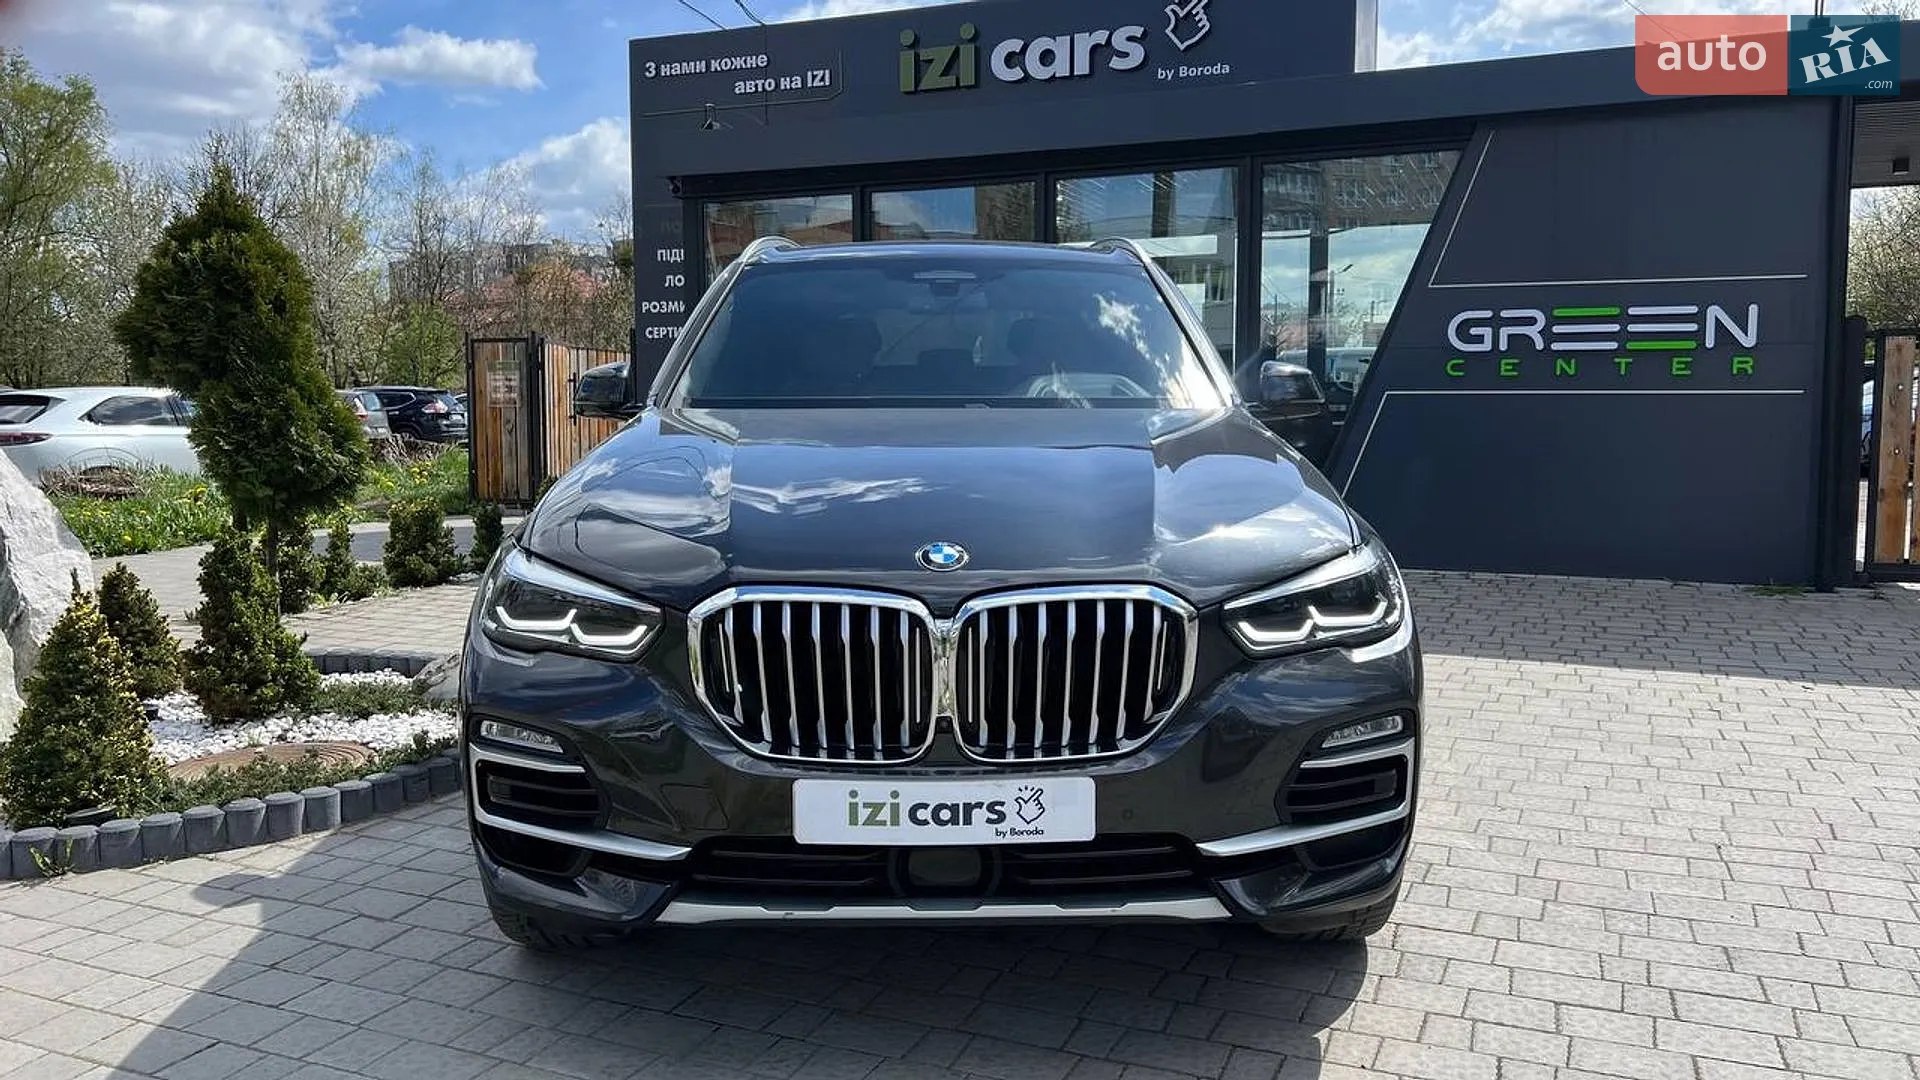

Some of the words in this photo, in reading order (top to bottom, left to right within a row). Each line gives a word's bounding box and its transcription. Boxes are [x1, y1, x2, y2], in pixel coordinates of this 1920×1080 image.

[660, 59, 706, 77] нами
[711, 54, 768, 73] кожне
[899, 23, 977, 92] izi
[990, 25, 1145, 82] cars
[734, 78, 776, 94] авто
[780, 74, 802, 90] на
[807, 69, 831, 87] IZI
[1157, 67, 1175, 82] by
[1179, 63, 1230, 78] Boroda
[1447, 303, 1759, 352] GREEN
[1445, 357, 1755, 376] CENTER
[848, 789, 900, 827] izi
[907, 799, 1007, 827] cars
[995, 827, 1008, 839] by
[1009, 826, 1044, 837] Boroda
